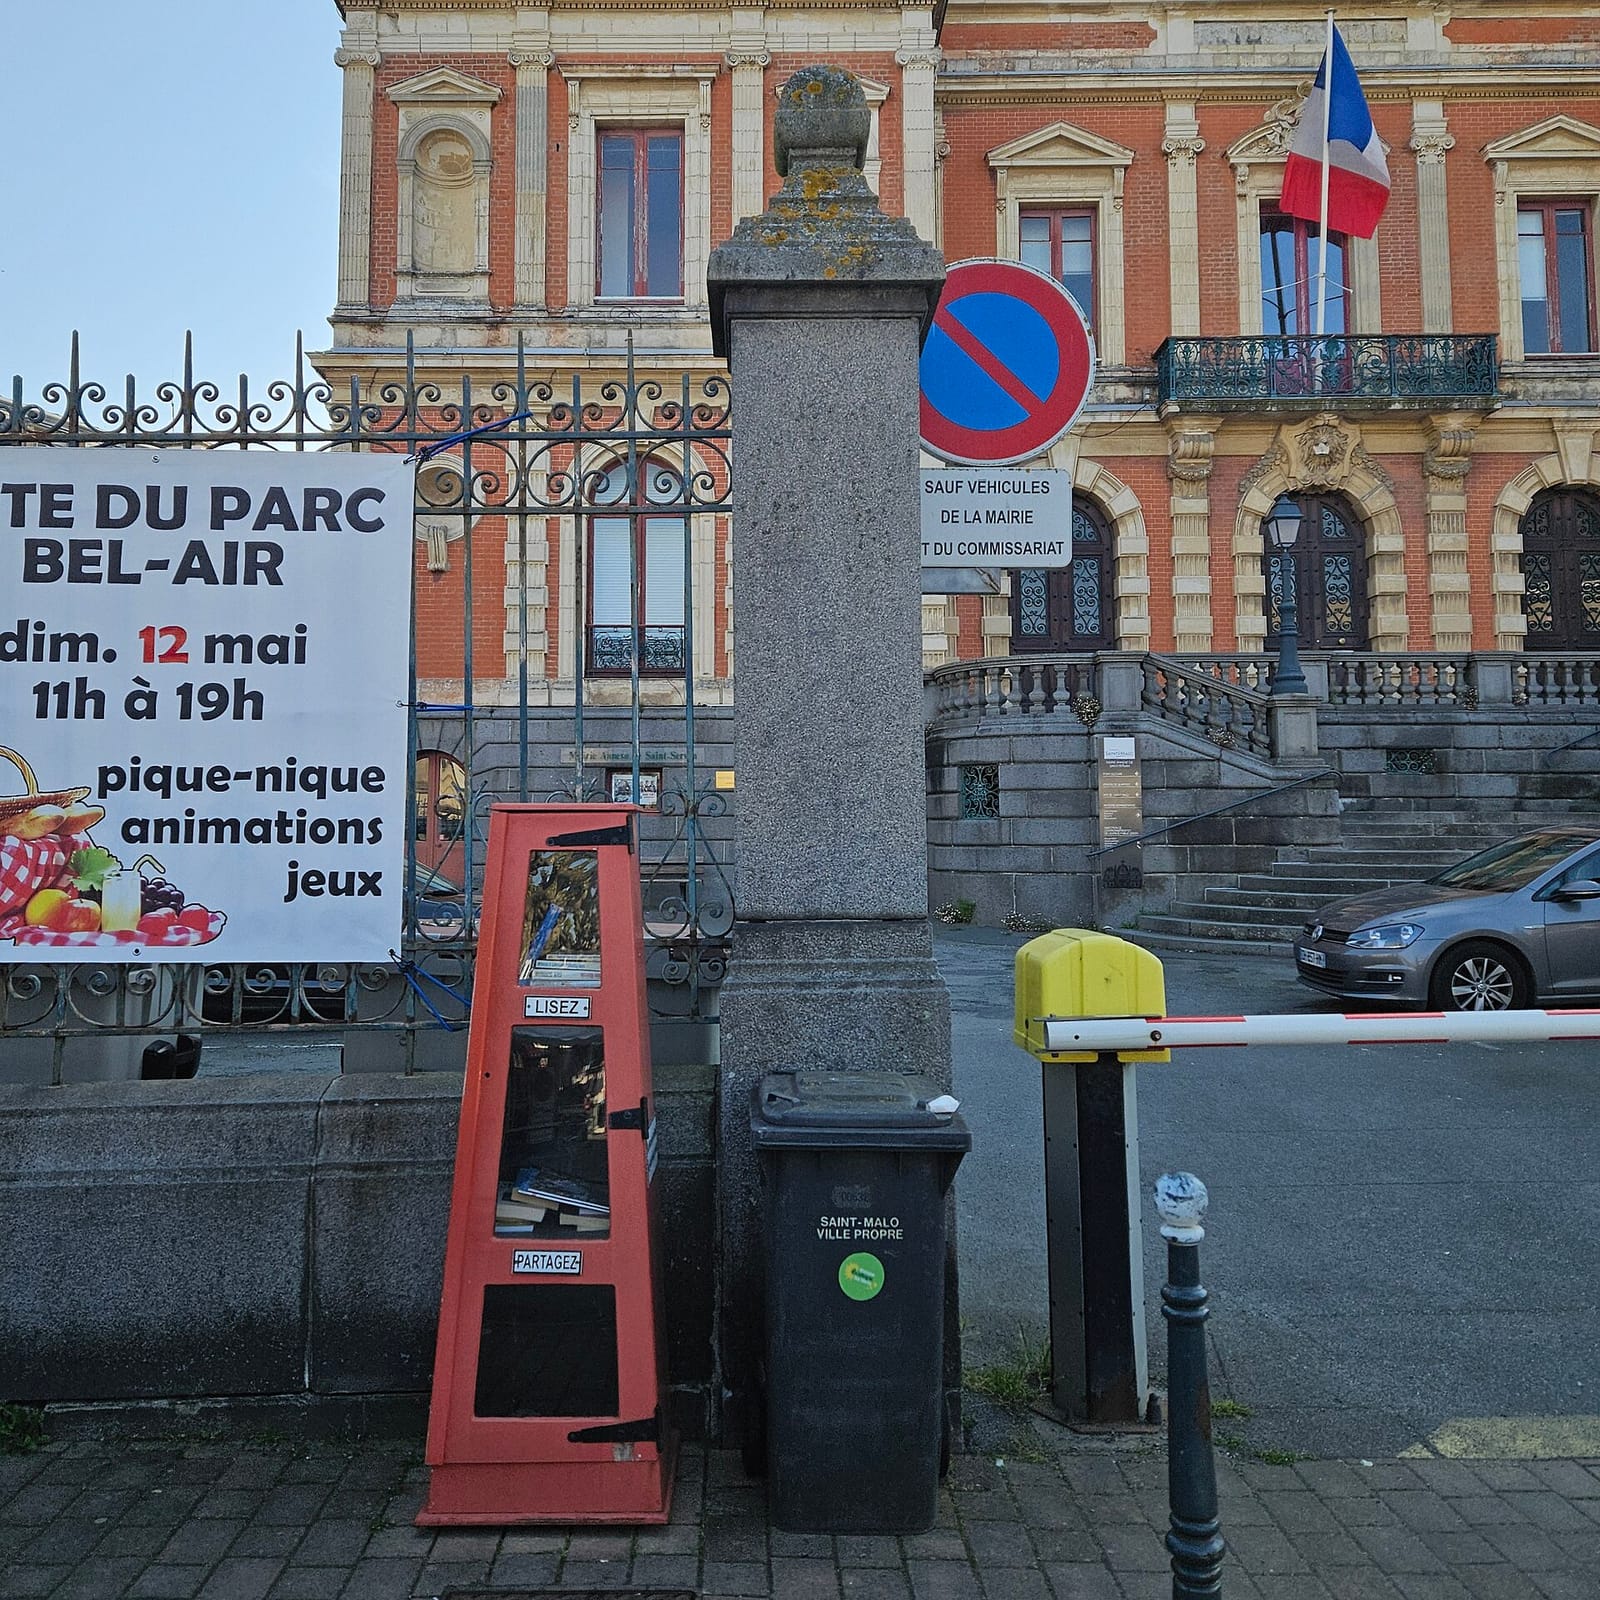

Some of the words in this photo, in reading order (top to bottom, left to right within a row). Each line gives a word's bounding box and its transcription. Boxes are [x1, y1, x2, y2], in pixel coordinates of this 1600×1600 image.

[925, 480, 963, 494] SAUF
[96, 484, 187, 531] DU
[210, 486, 386, 533] PARC
[941, 510, 959, 523] DE
[964, 510, 982, 523] LA
[986, 510, 1034, 524] MAIRIE
[934, 542, 952, 555] DU
[957, 541, 1064, 555] COMMISSARIAT
[23, 538, 284, 585] BEL-AIR
[0, 619, 117, 664] dim.
[139, 625, 189, 664] 12
[204, 624, 307, 665] mai
[33, 676, 105, 720] 11h
[124, 676, 158, 720] à
[176, 677, 263, 721] 19h
[98, 756, 385, 799] pique-nique
[121, 808, 383, 844] animations
[284, 861, 382, 902] jeux
[535, 999, 579, 1014] LISEZ
[816, 1228, 851, 1240] VILLE
[854, 1228, 904, 1240] PROPRE
[820, 1216, 900, 1228] SAINT-MALO
[516, 1254, 578, 1270] PARTAGEZ
